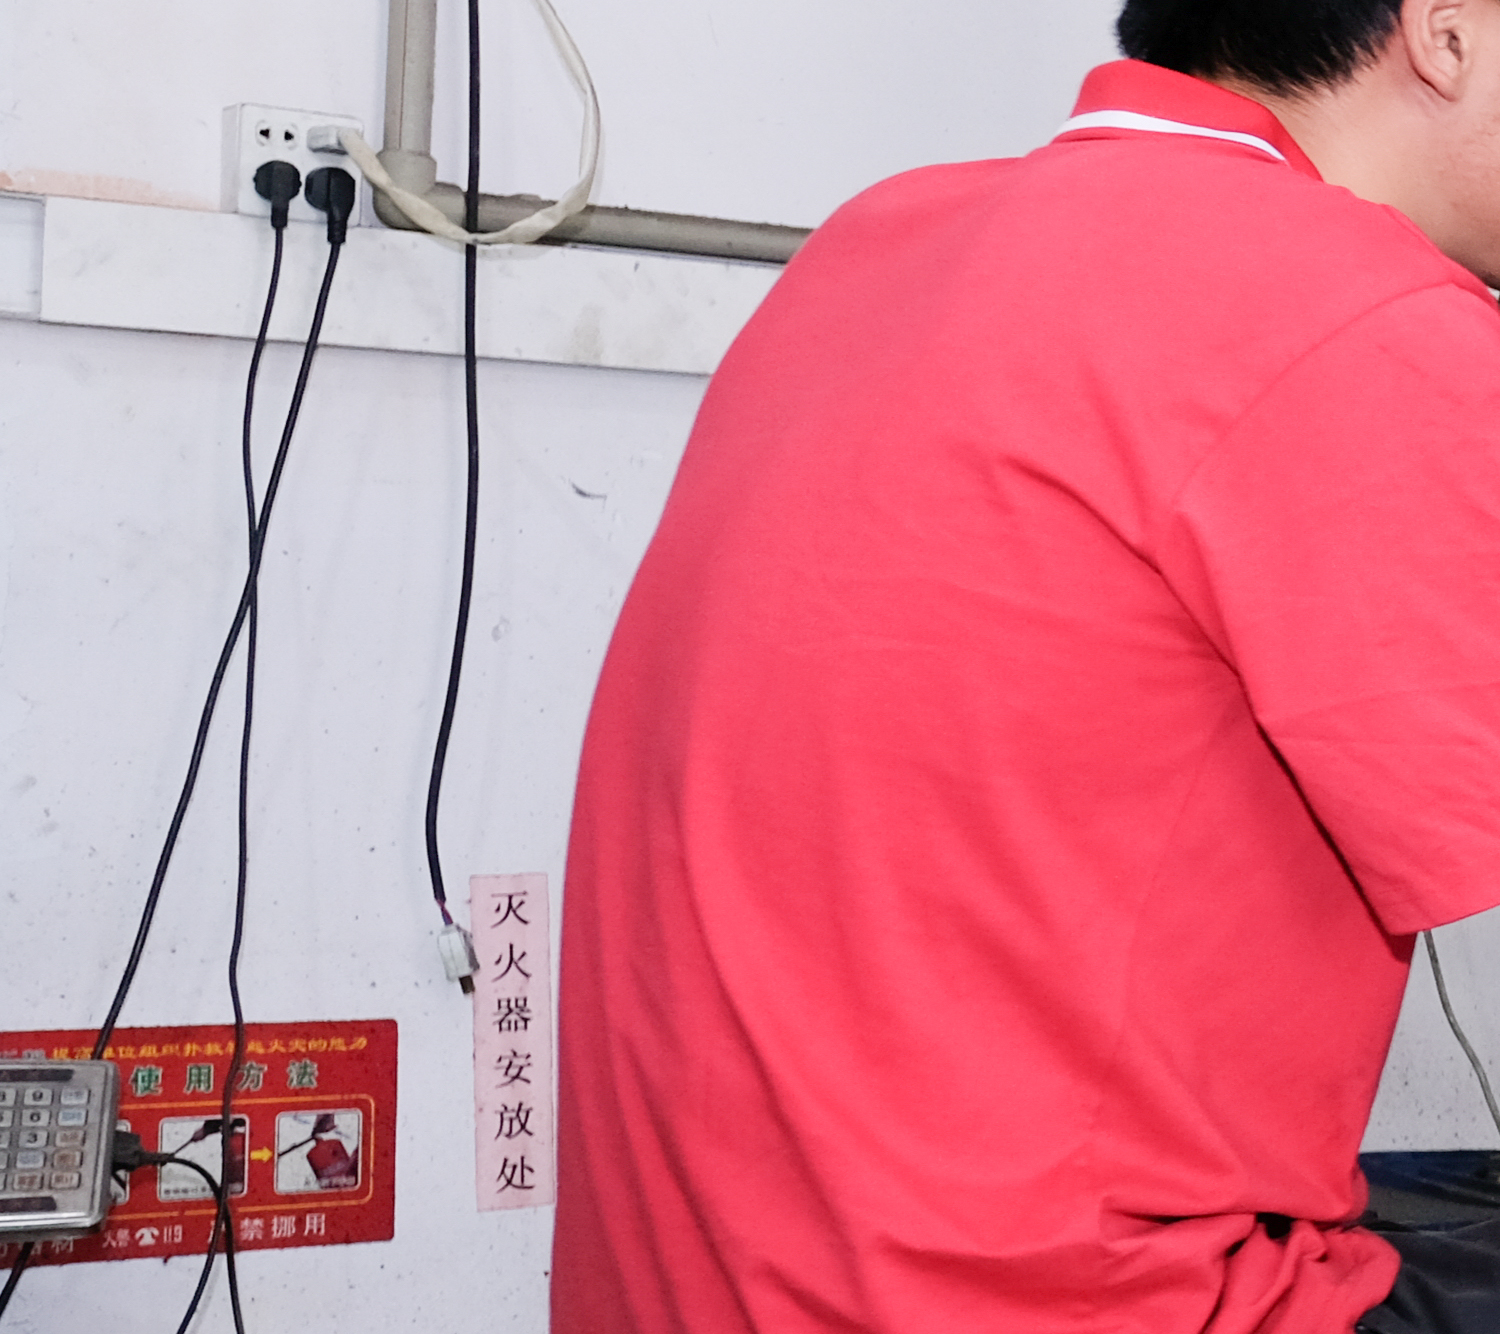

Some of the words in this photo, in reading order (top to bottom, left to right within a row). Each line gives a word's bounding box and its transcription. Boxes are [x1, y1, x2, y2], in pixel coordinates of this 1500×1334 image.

[491, 890, 535, 1194] 灭火器安放处
[129, 1060, 318, 1096] 使用方法
[163, 1224, 183, 1245] 119
